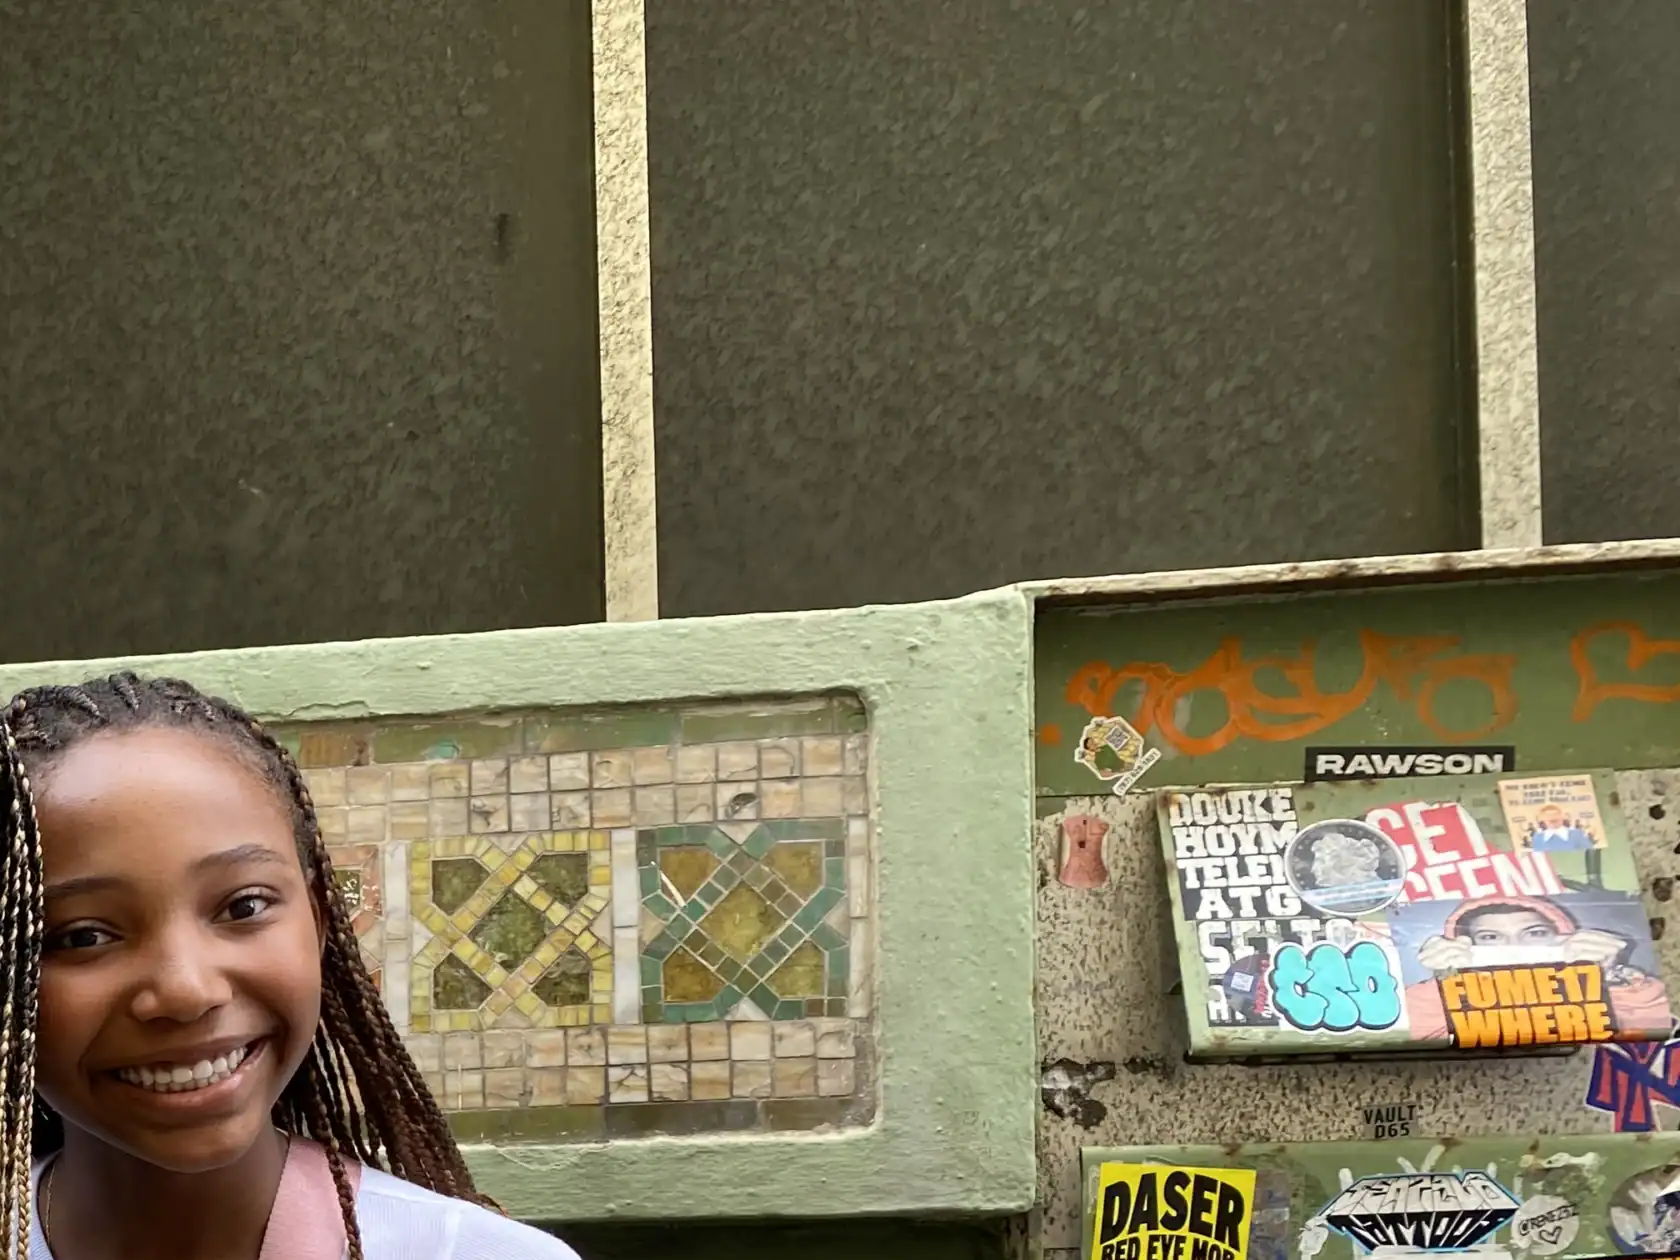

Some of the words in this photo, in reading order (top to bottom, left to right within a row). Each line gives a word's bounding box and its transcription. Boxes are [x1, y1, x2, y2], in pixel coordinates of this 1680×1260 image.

[1316, 754, 1504, 775] RAWSON
[1442, 965, 1601, 1011] FUME17
[1450, 1003, 1613, 1048] WHERE
[1363, 1104, 1417, 1125] VAULT
[1375, 1122, 1410, 1139] D65
[1099, 1171, 1245, 1253] DASER
